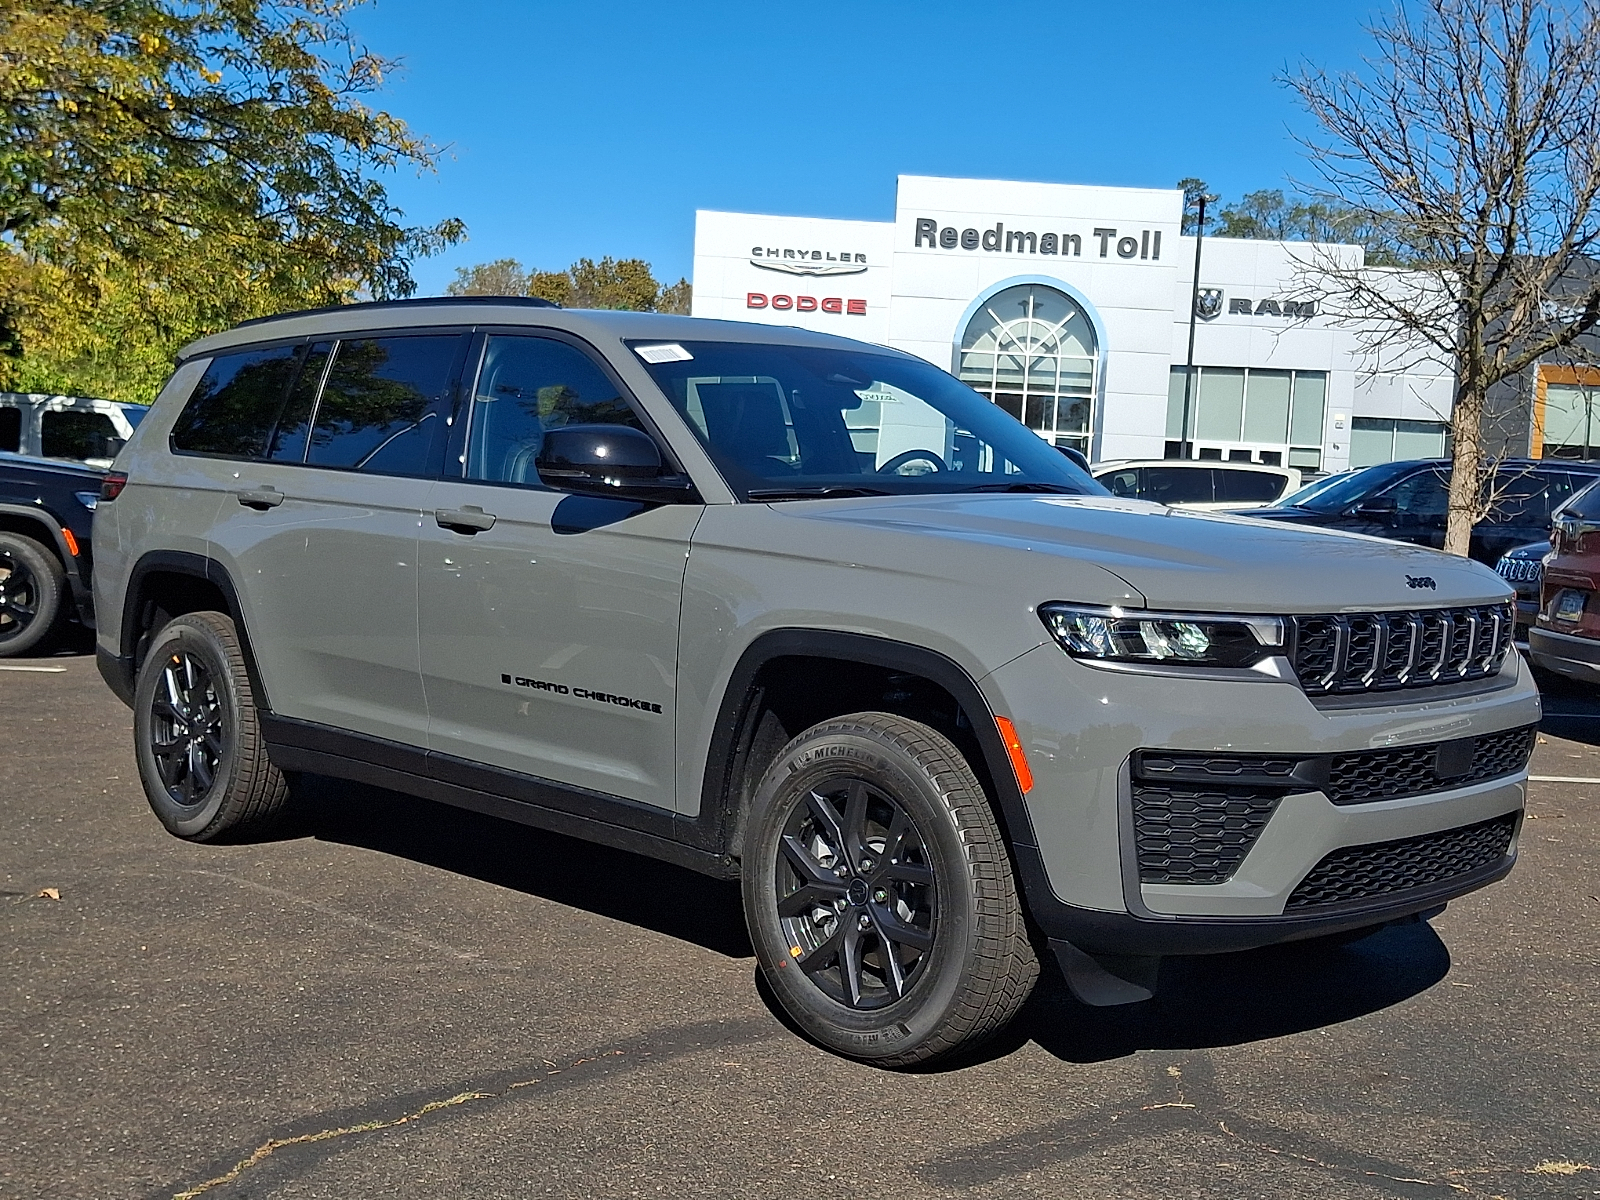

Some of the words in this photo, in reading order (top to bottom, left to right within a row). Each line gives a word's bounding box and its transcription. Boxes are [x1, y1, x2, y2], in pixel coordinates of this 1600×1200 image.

[915, 218, 1082, 256] Reedman
[1093, 227, 1162, 261] Toll
[751, 246, 867, 263] CHRYSLER
[747, 292, 867, 316] DODGE
[1228, 298, 1315, 317] RAM
[515, 676, 569, 695] GRAND
[572, 687, 662, 715] CHEROKEE
